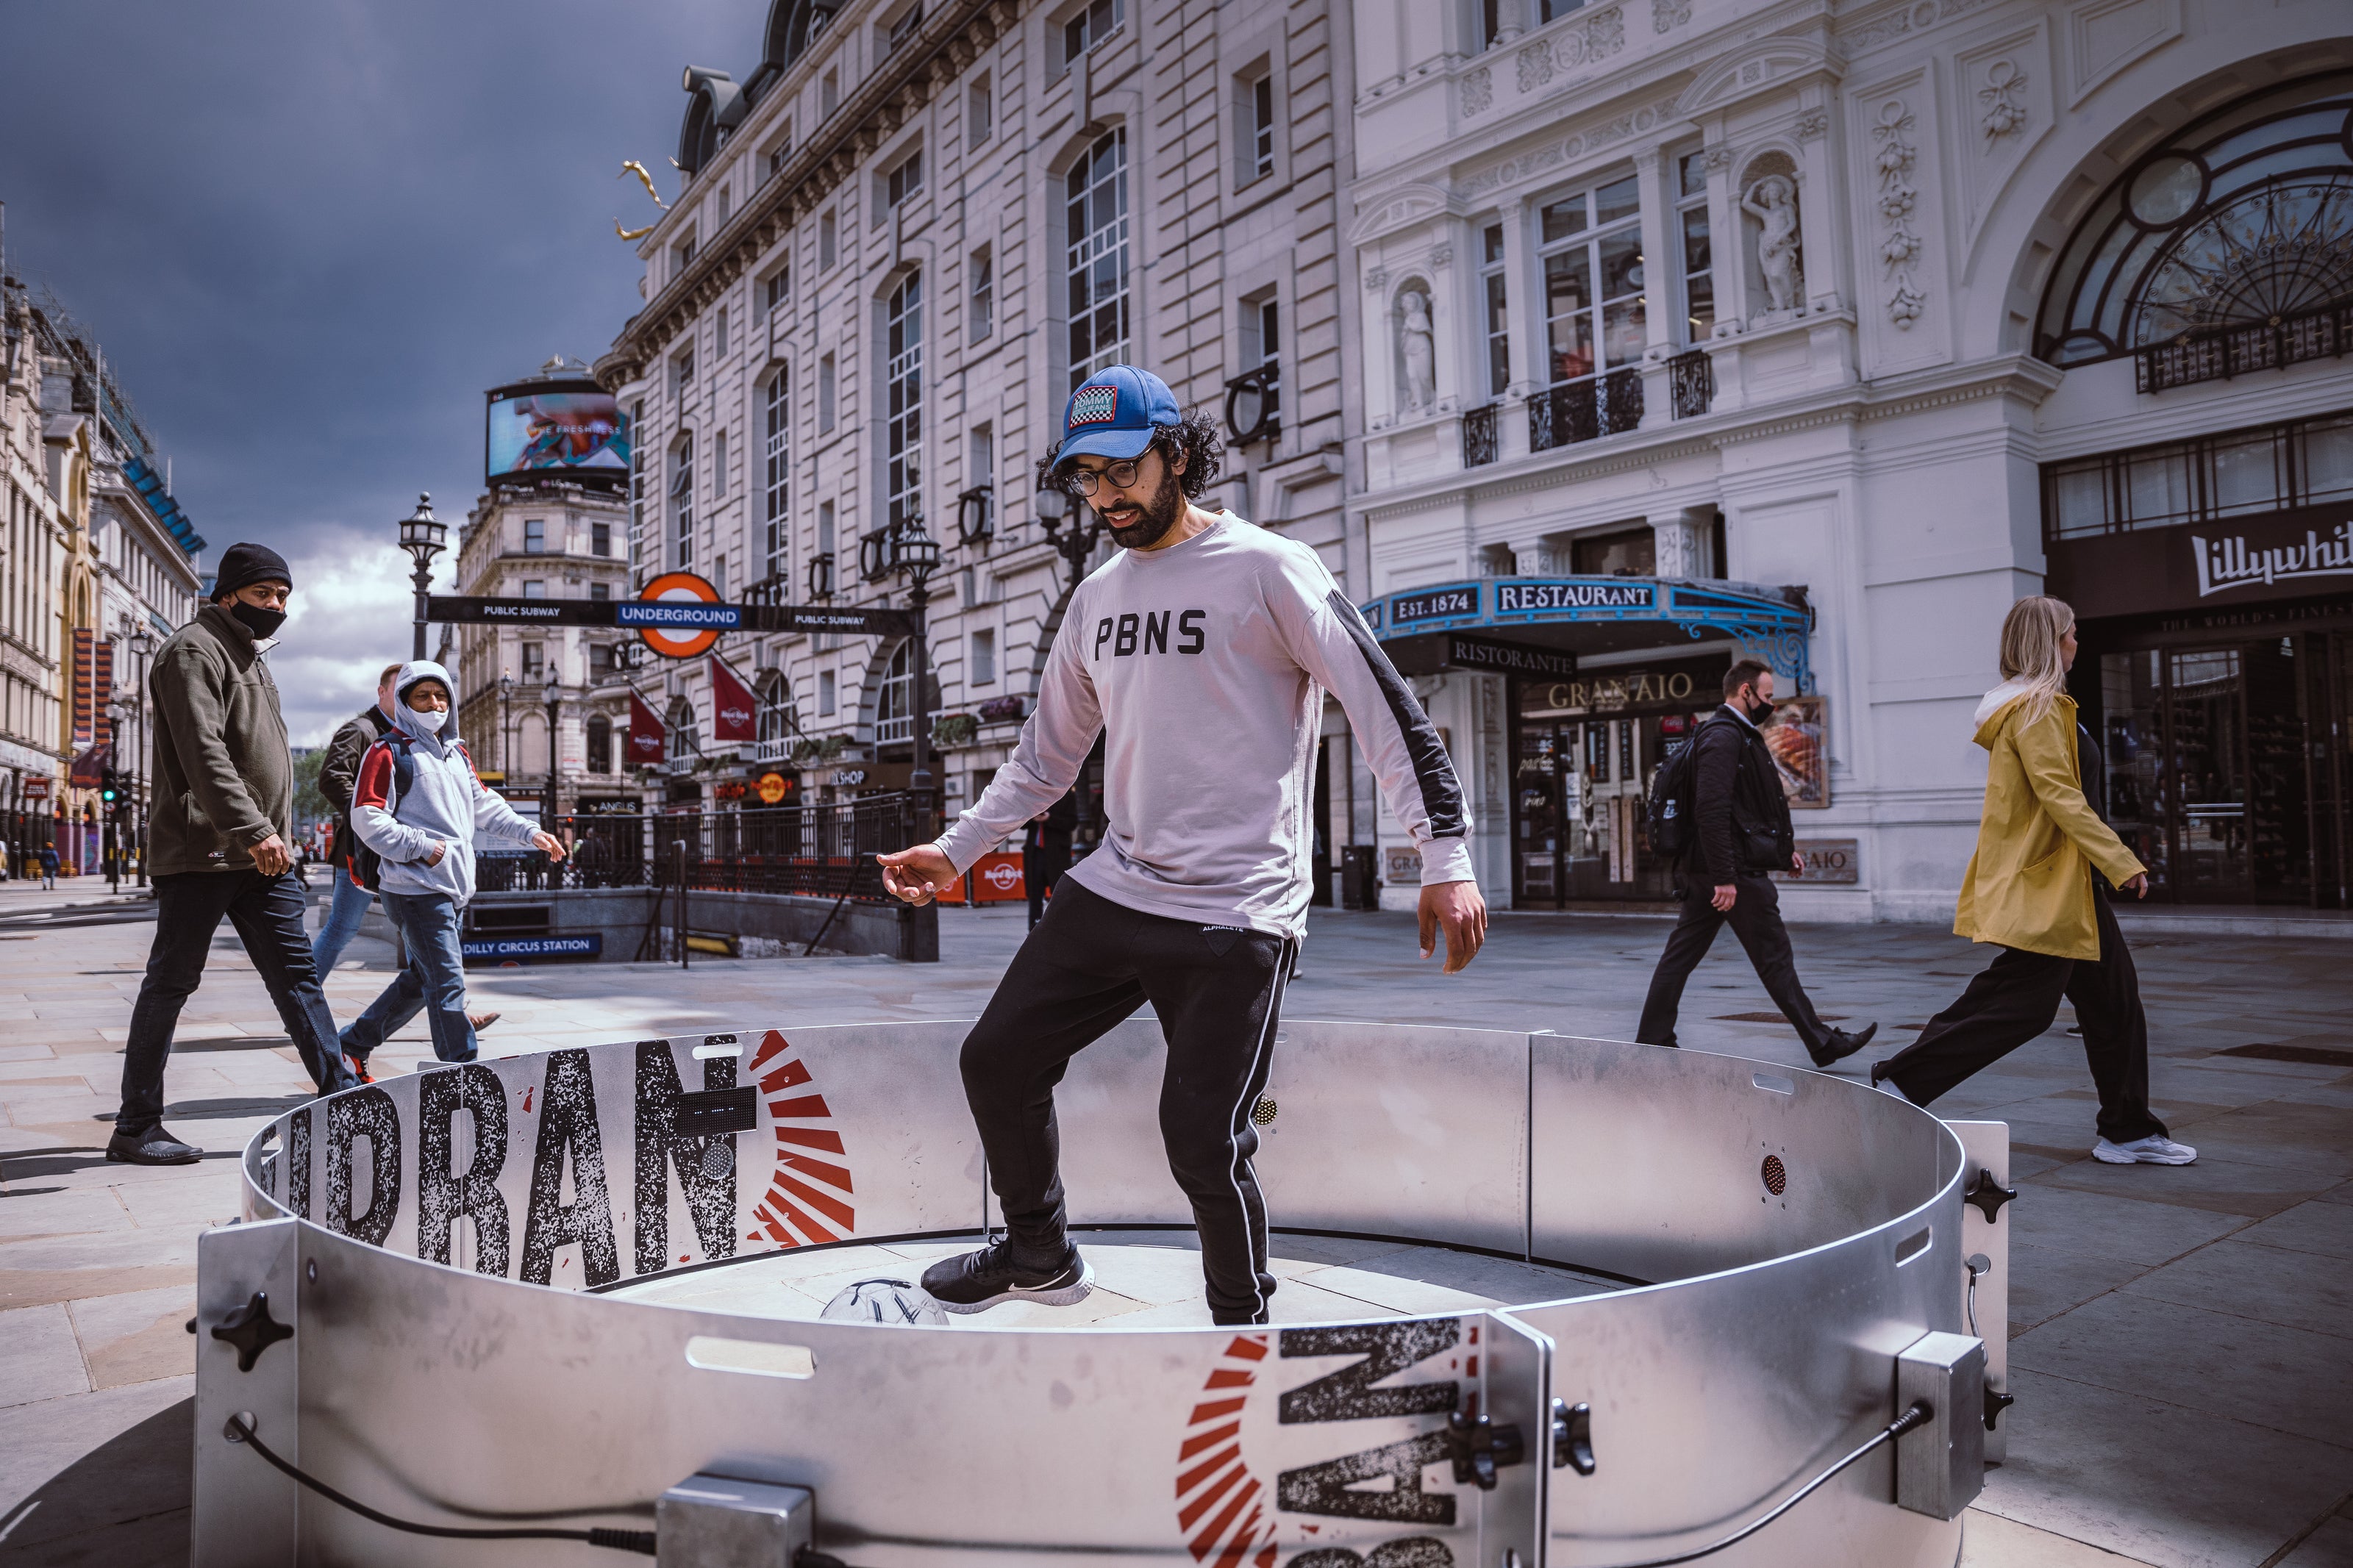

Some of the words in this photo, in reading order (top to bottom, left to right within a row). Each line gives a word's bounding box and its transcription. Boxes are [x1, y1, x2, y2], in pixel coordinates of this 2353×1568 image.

[1074, 397, 1112, 409] TOMMY
[1086, 404, 1110, 412] JEANS
[557, 425, 621, 435] FRESHNESS
[1432, 593, 1469, 615] 1874
[1501, 585, 1649, 610] RESTAURANT
[484, 606, 518, 616] PUBLIC
[521, 607, 560, 617] SUBWAY
[621, 607, 737, 623] UNDERGROUND
[794, 614, 826, 624] PUBLIC
[829, 615, 865, 625] SUBWAY
[1095, 609, 1206, 662] PBNS
[1455, 640, 1573, 675] RISTORANTE
[1548, 672, 1693, 709] GRANAIO
[840, 770, 865, 785] SHOP
[1802, 851, 1846, 868] AIO
[462, 942, 495, 954] DILLY
[498, 941, 540, 953] CIRCUS
[543, 939, 590, 952] STATION
